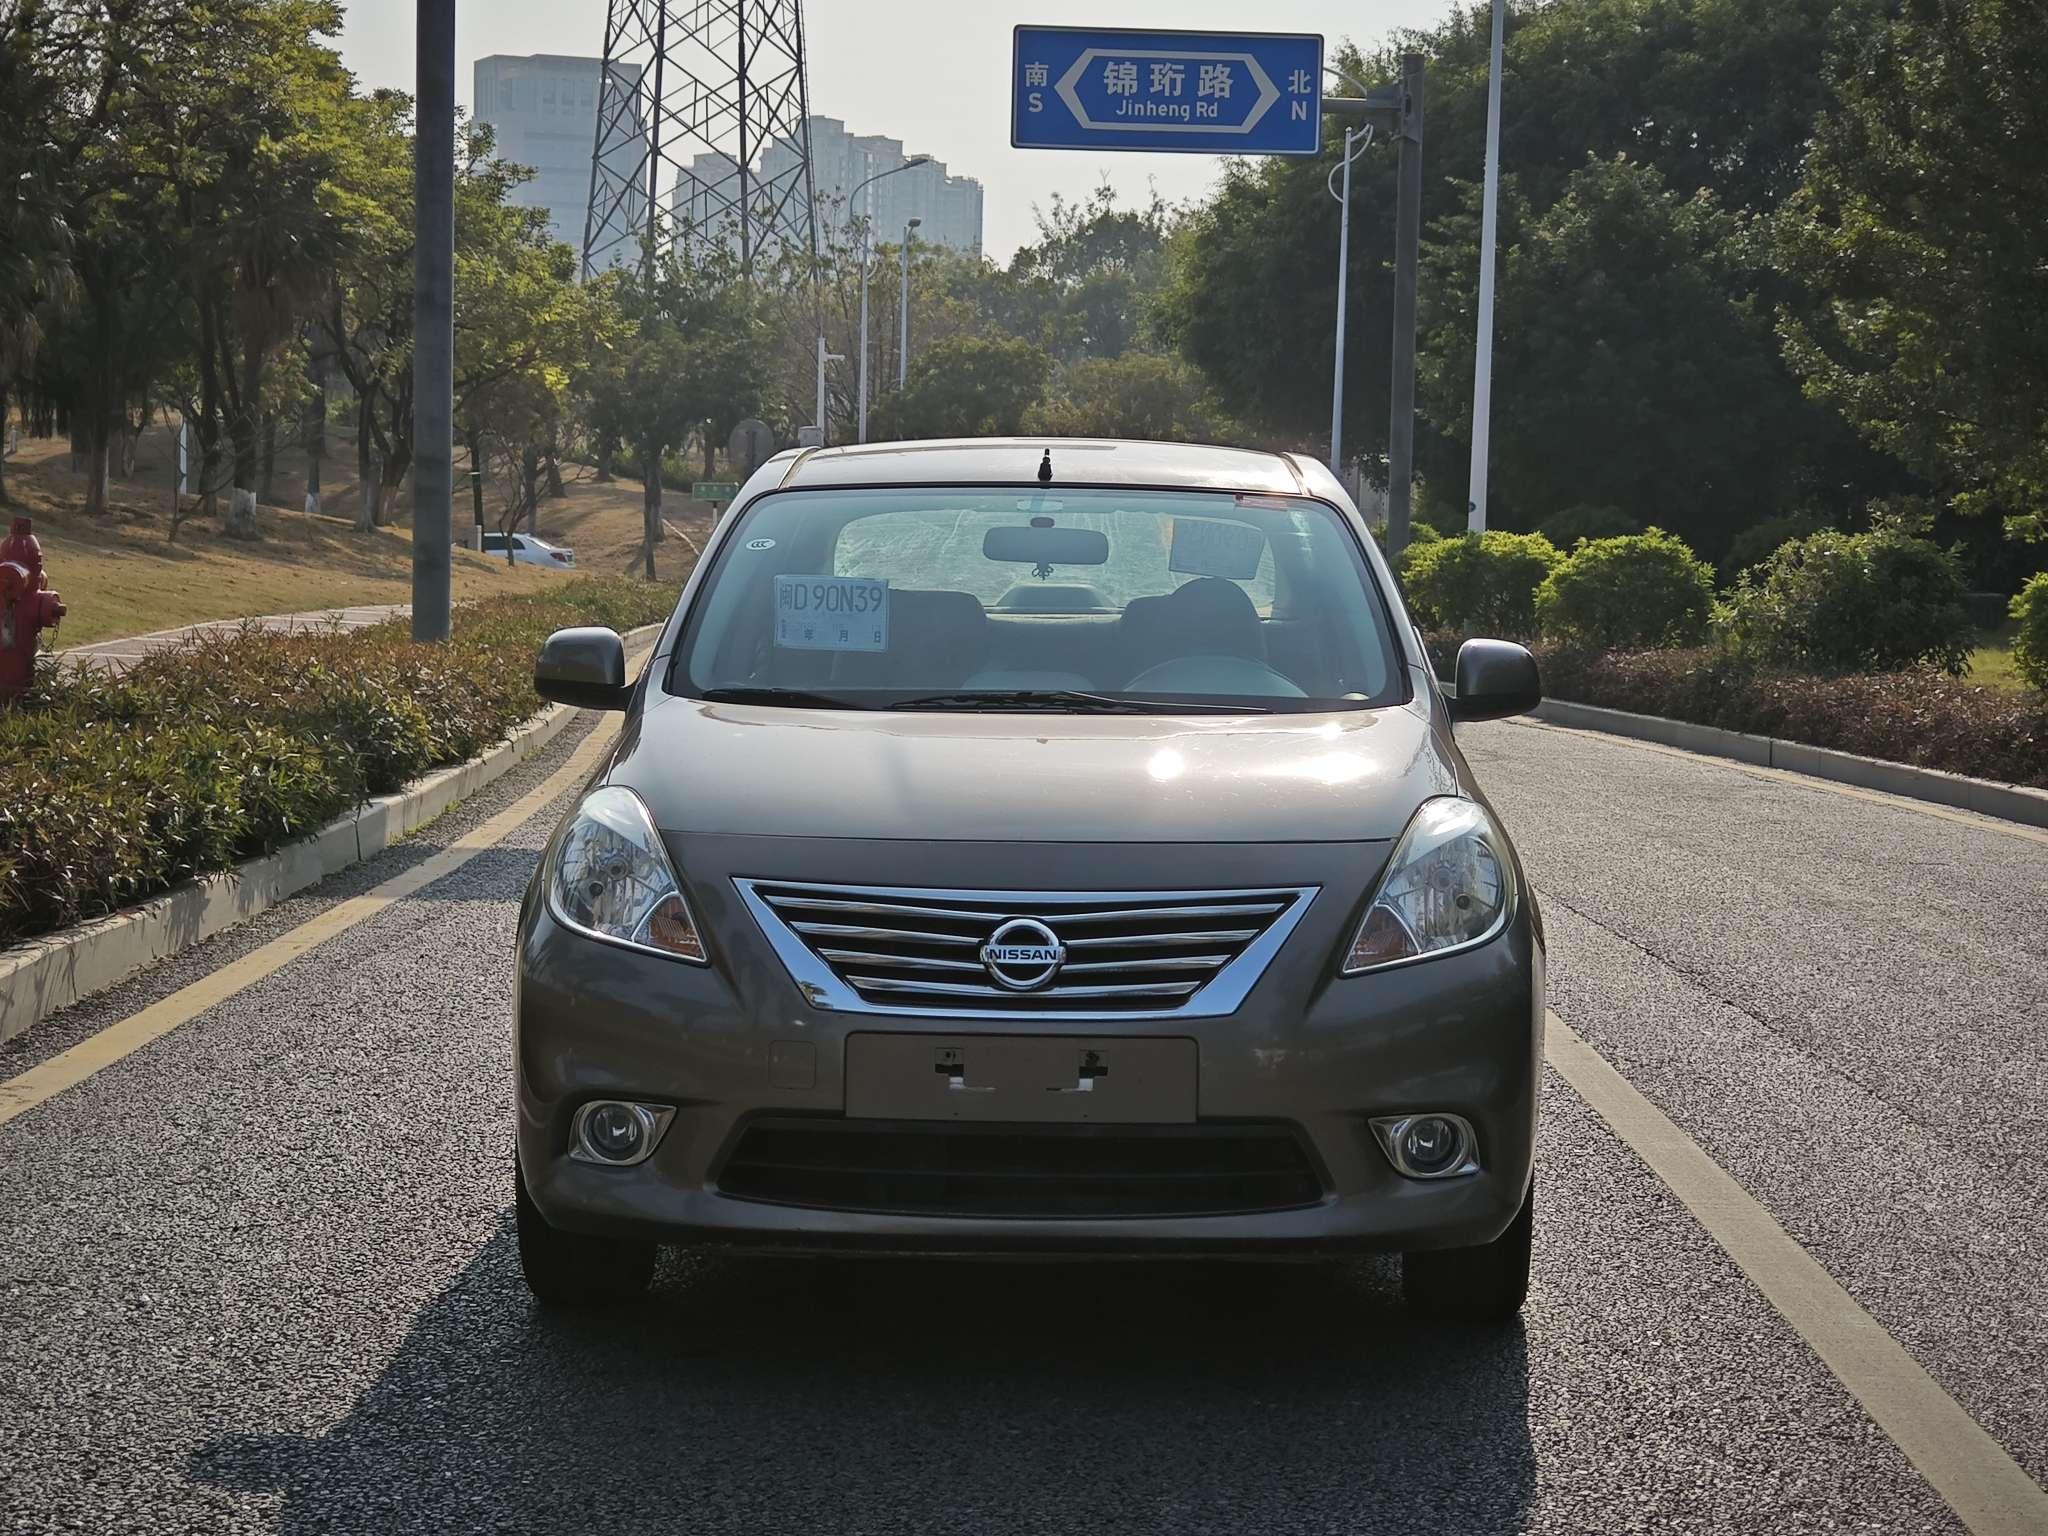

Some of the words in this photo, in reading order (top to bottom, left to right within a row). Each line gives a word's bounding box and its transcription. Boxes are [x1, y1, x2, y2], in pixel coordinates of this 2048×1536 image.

[1025, 62, 1049, 87] 南
[1103, 62, 1233, 99] 锦珩路
[1288, 69, 1312, 95] 北
[1028, 92, 1044, 113] S
[1115, 100, 1190, 121] Jinheng
[1196, 101, 1218, 118] Rd
[1291, 101, 1307, 121] N
[989, 949, 1057, 960] NISSAN
